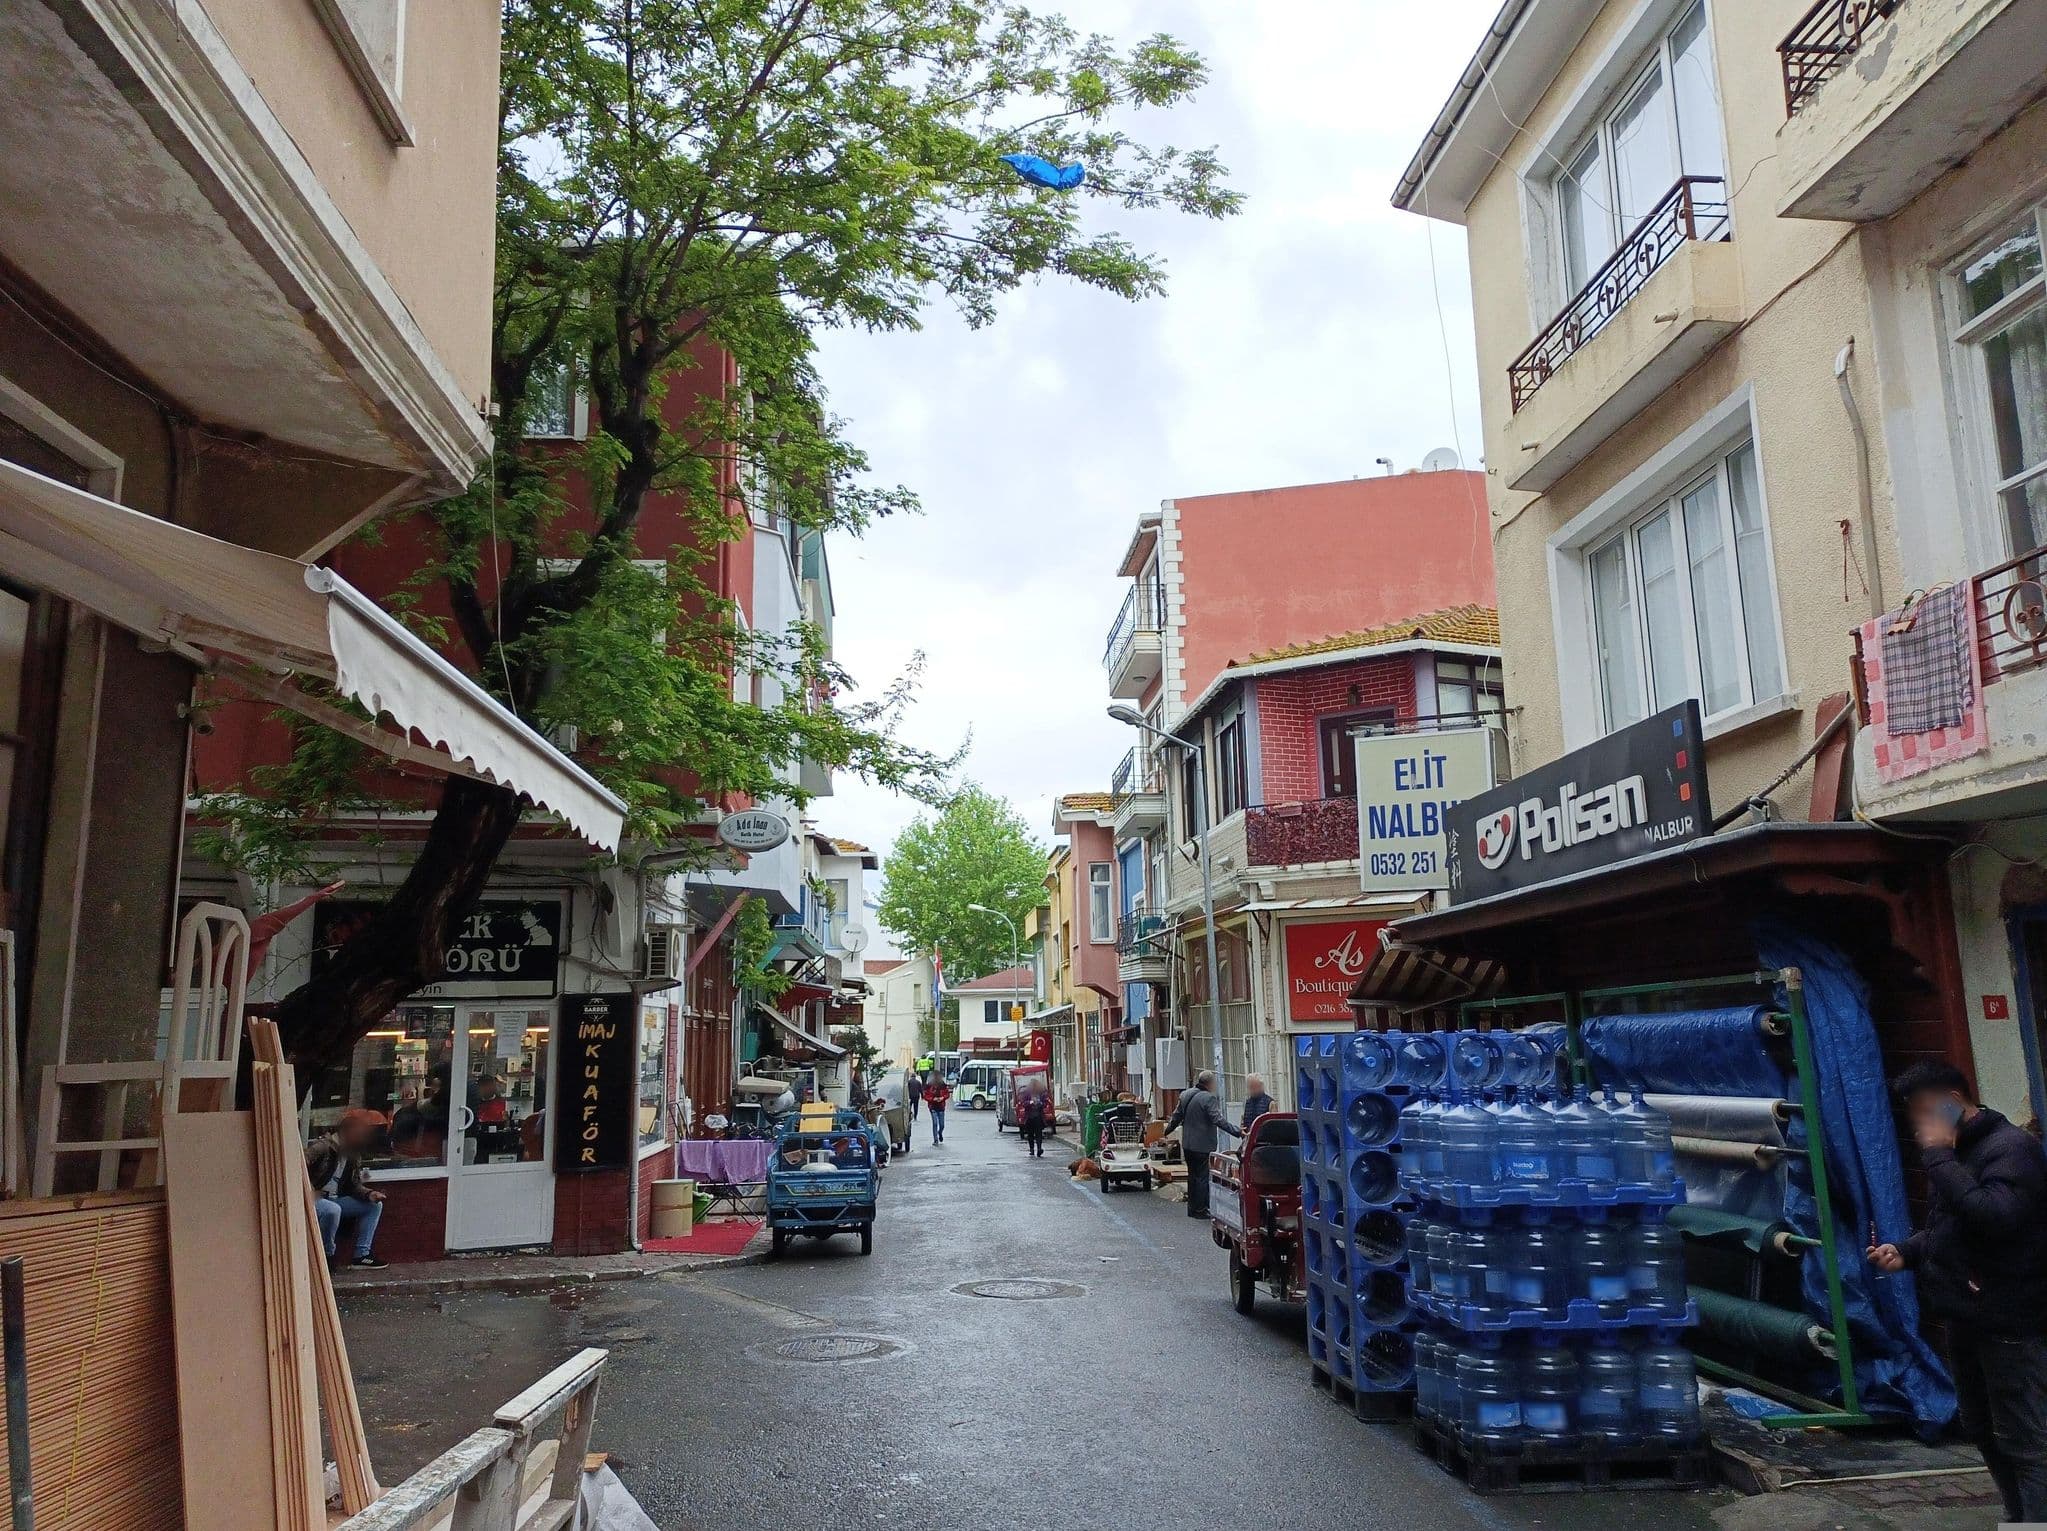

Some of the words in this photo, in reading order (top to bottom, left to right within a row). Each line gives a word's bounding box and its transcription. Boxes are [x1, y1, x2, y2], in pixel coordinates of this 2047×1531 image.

[1394, 749, 1447, 791] ELİT
[1518, 774, 1649, 861] Polisan
[1644, 815, 1694, 843] NALBUR
[1371, 852, 1406, 876] 0532
[1411, 851, 1437, 874] 251
[1314, 929, 1364, 976] As
[1314, 1003, 1336, 1014] 0216
[578, 1021, 616, 1040] İMAJ
